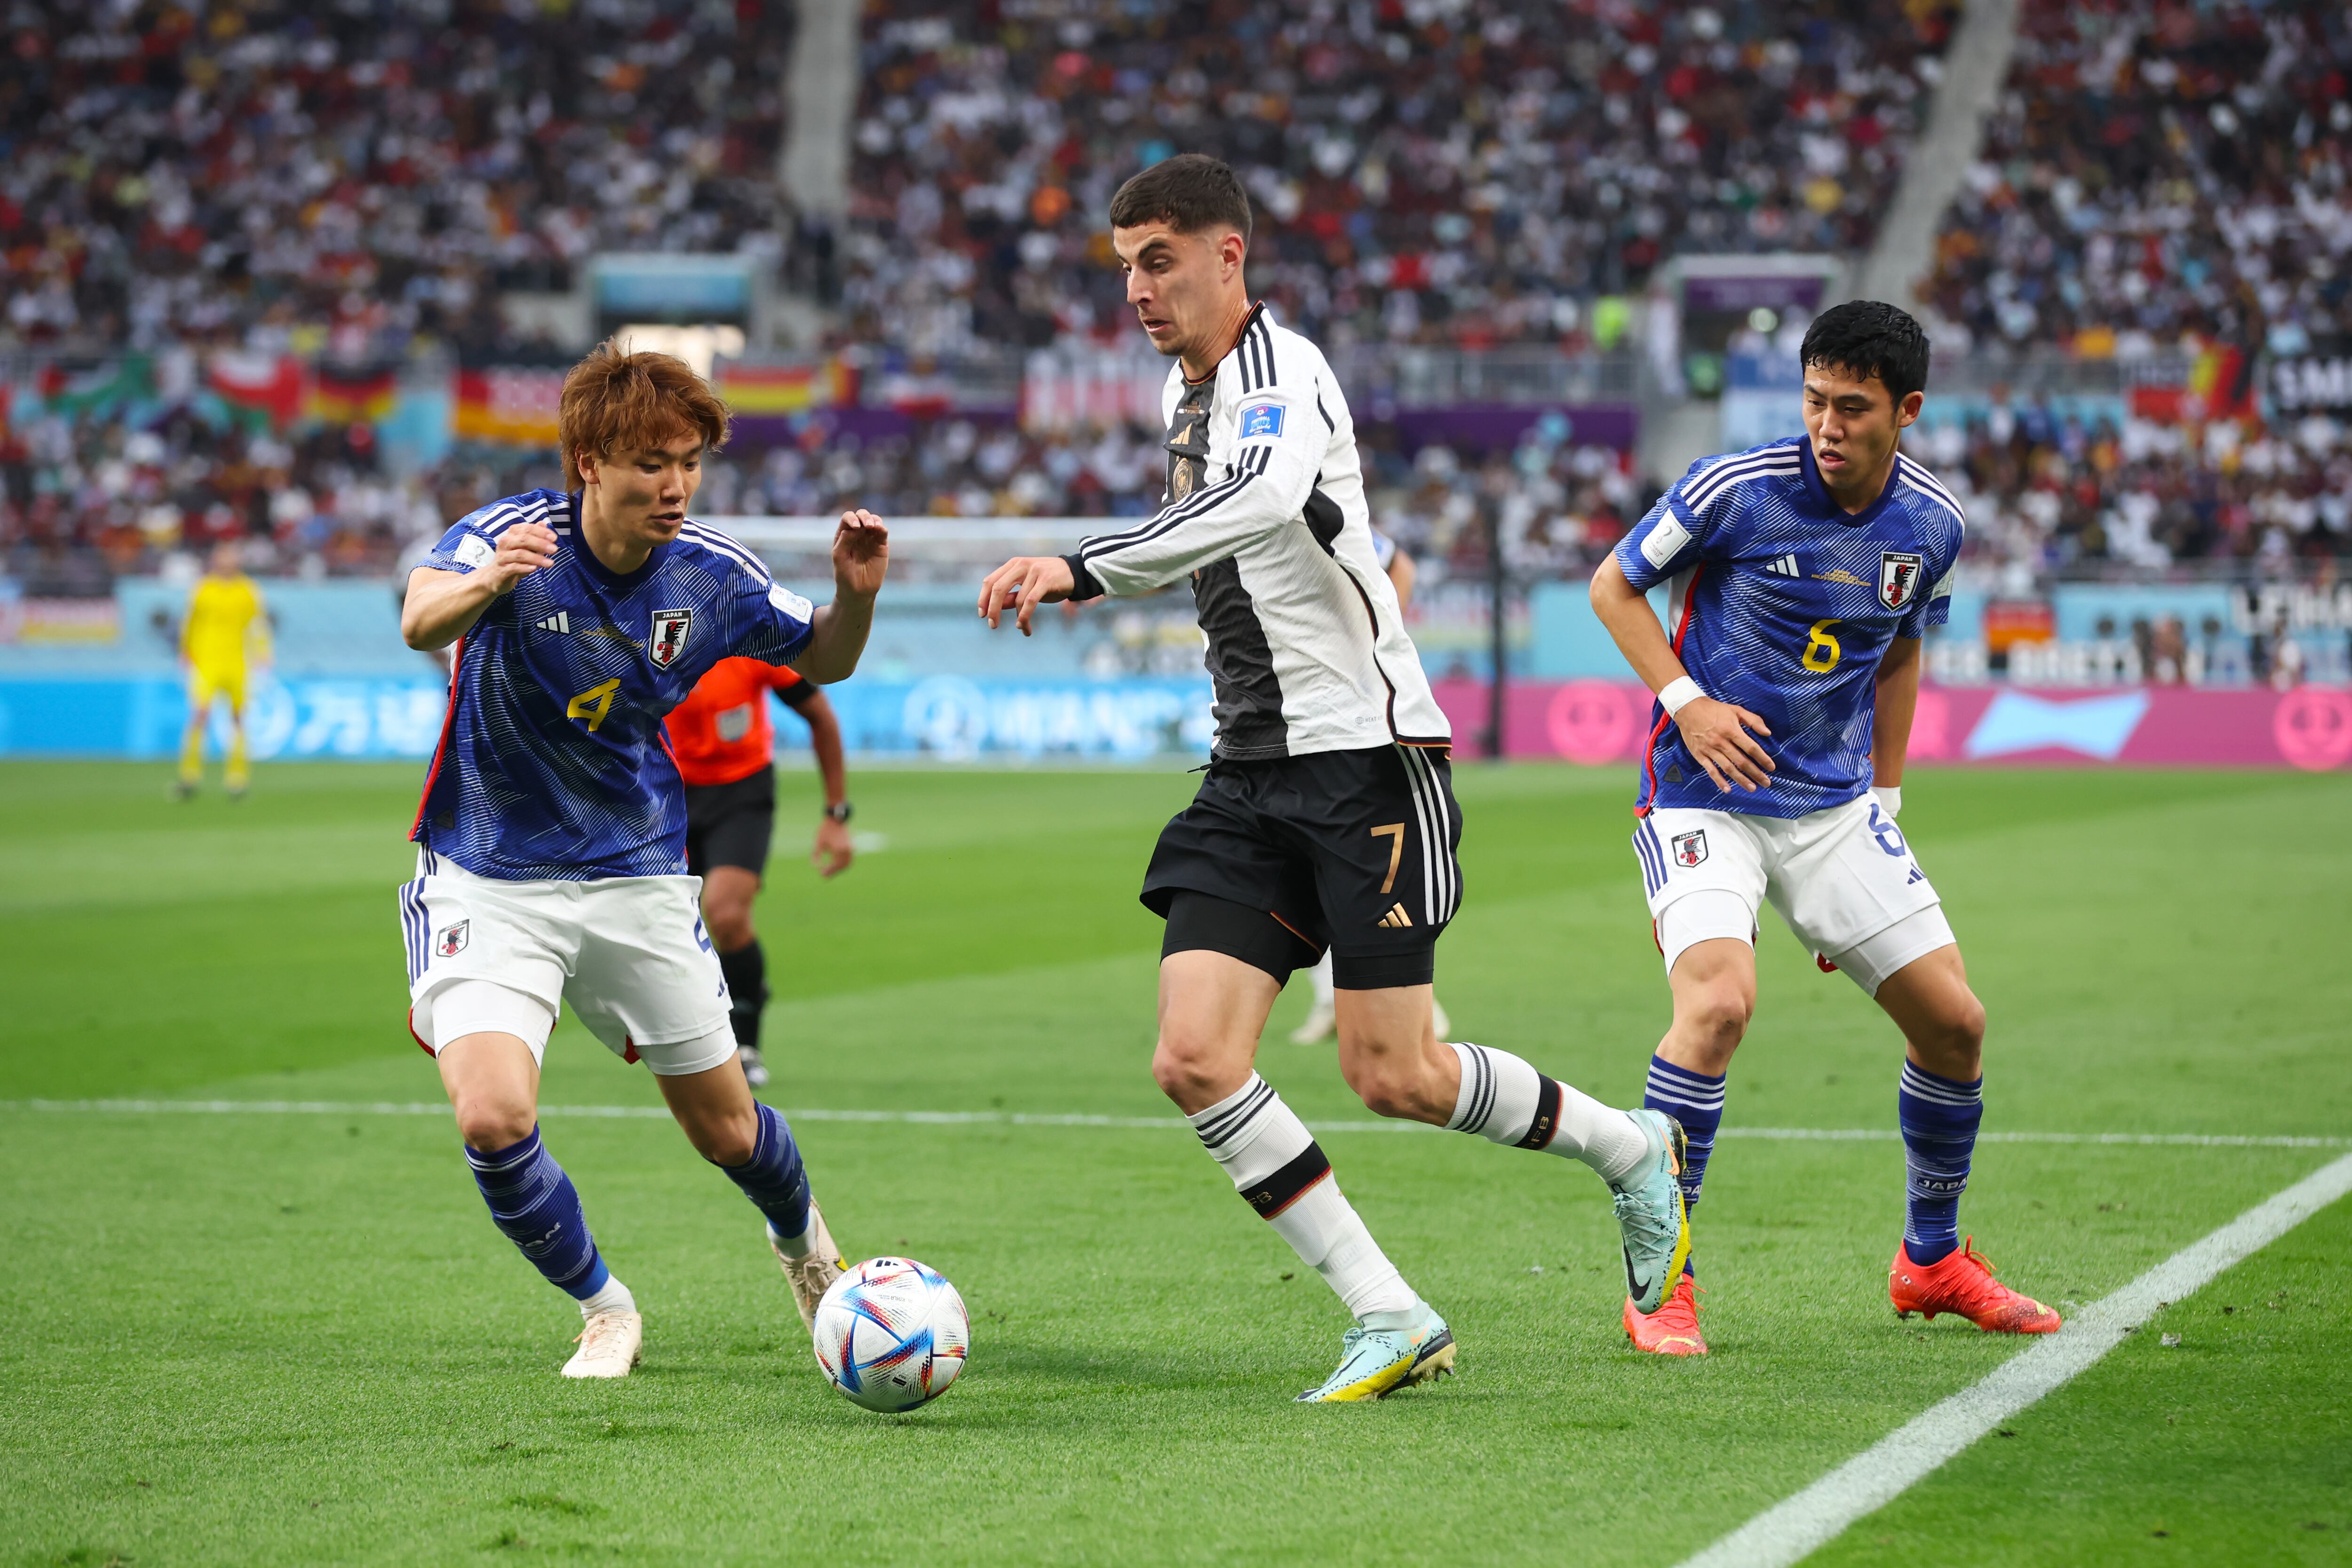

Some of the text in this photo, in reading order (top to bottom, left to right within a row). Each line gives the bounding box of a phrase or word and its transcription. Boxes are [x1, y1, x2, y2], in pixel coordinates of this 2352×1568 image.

[1803, 619, 1840, 673] 6
[567, 678, 621, 732] 4
[1678, 832, 1697, 840] JAPAN
[1868, 803, 1906, 857] 6
[1370, 822, 1405, 894] 7
[1247, 1191, 1272, 1208] FB
[1919, 1177, 1967, 1190] JAPA
